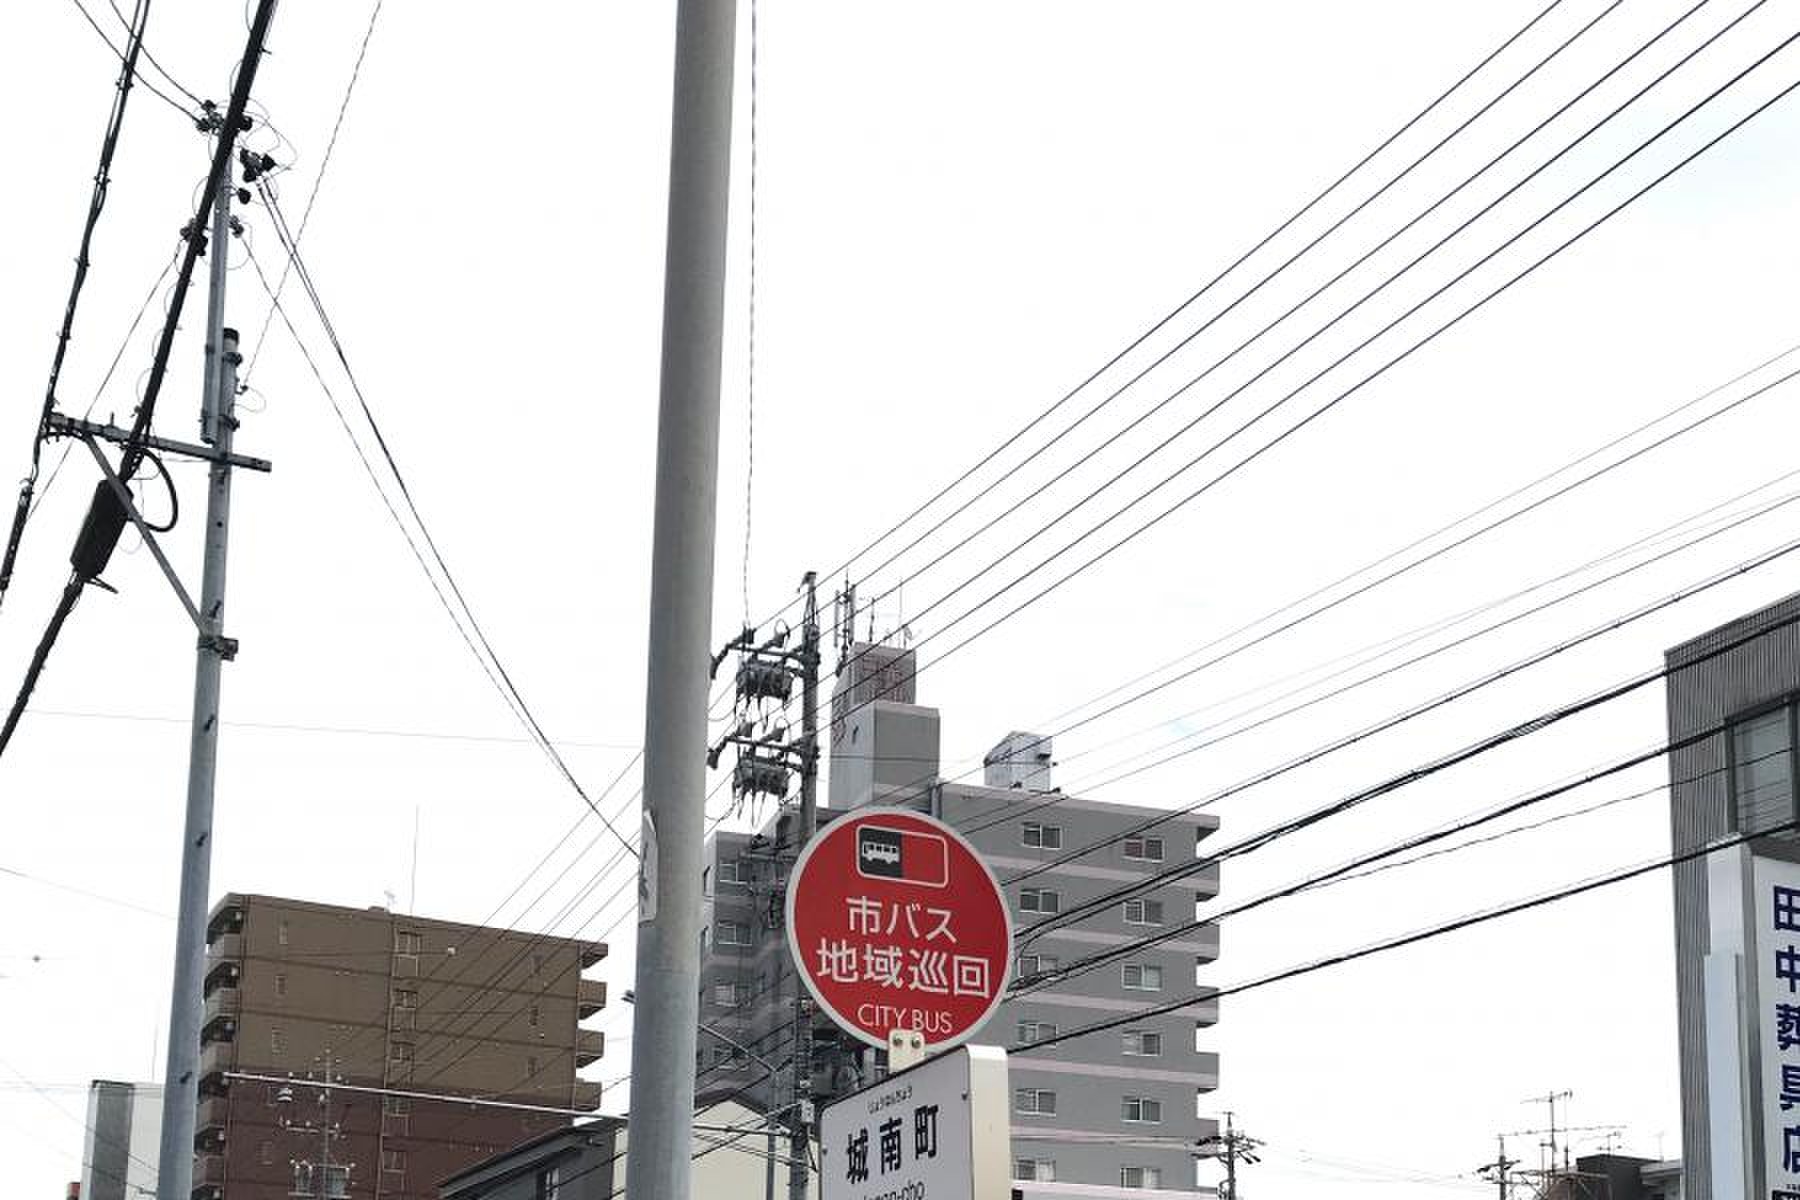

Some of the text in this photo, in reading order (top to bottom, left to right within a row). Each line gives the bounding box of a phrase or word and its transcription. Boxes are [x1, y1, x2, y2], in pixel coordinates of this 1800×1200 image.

[846, 895, 957, 943] 市バス
[816, 938, 990, 998] 地域巡回
[857, 1003, 953, 1034] CITY BUS
[846, 1104, 939, 1185] 城南町
